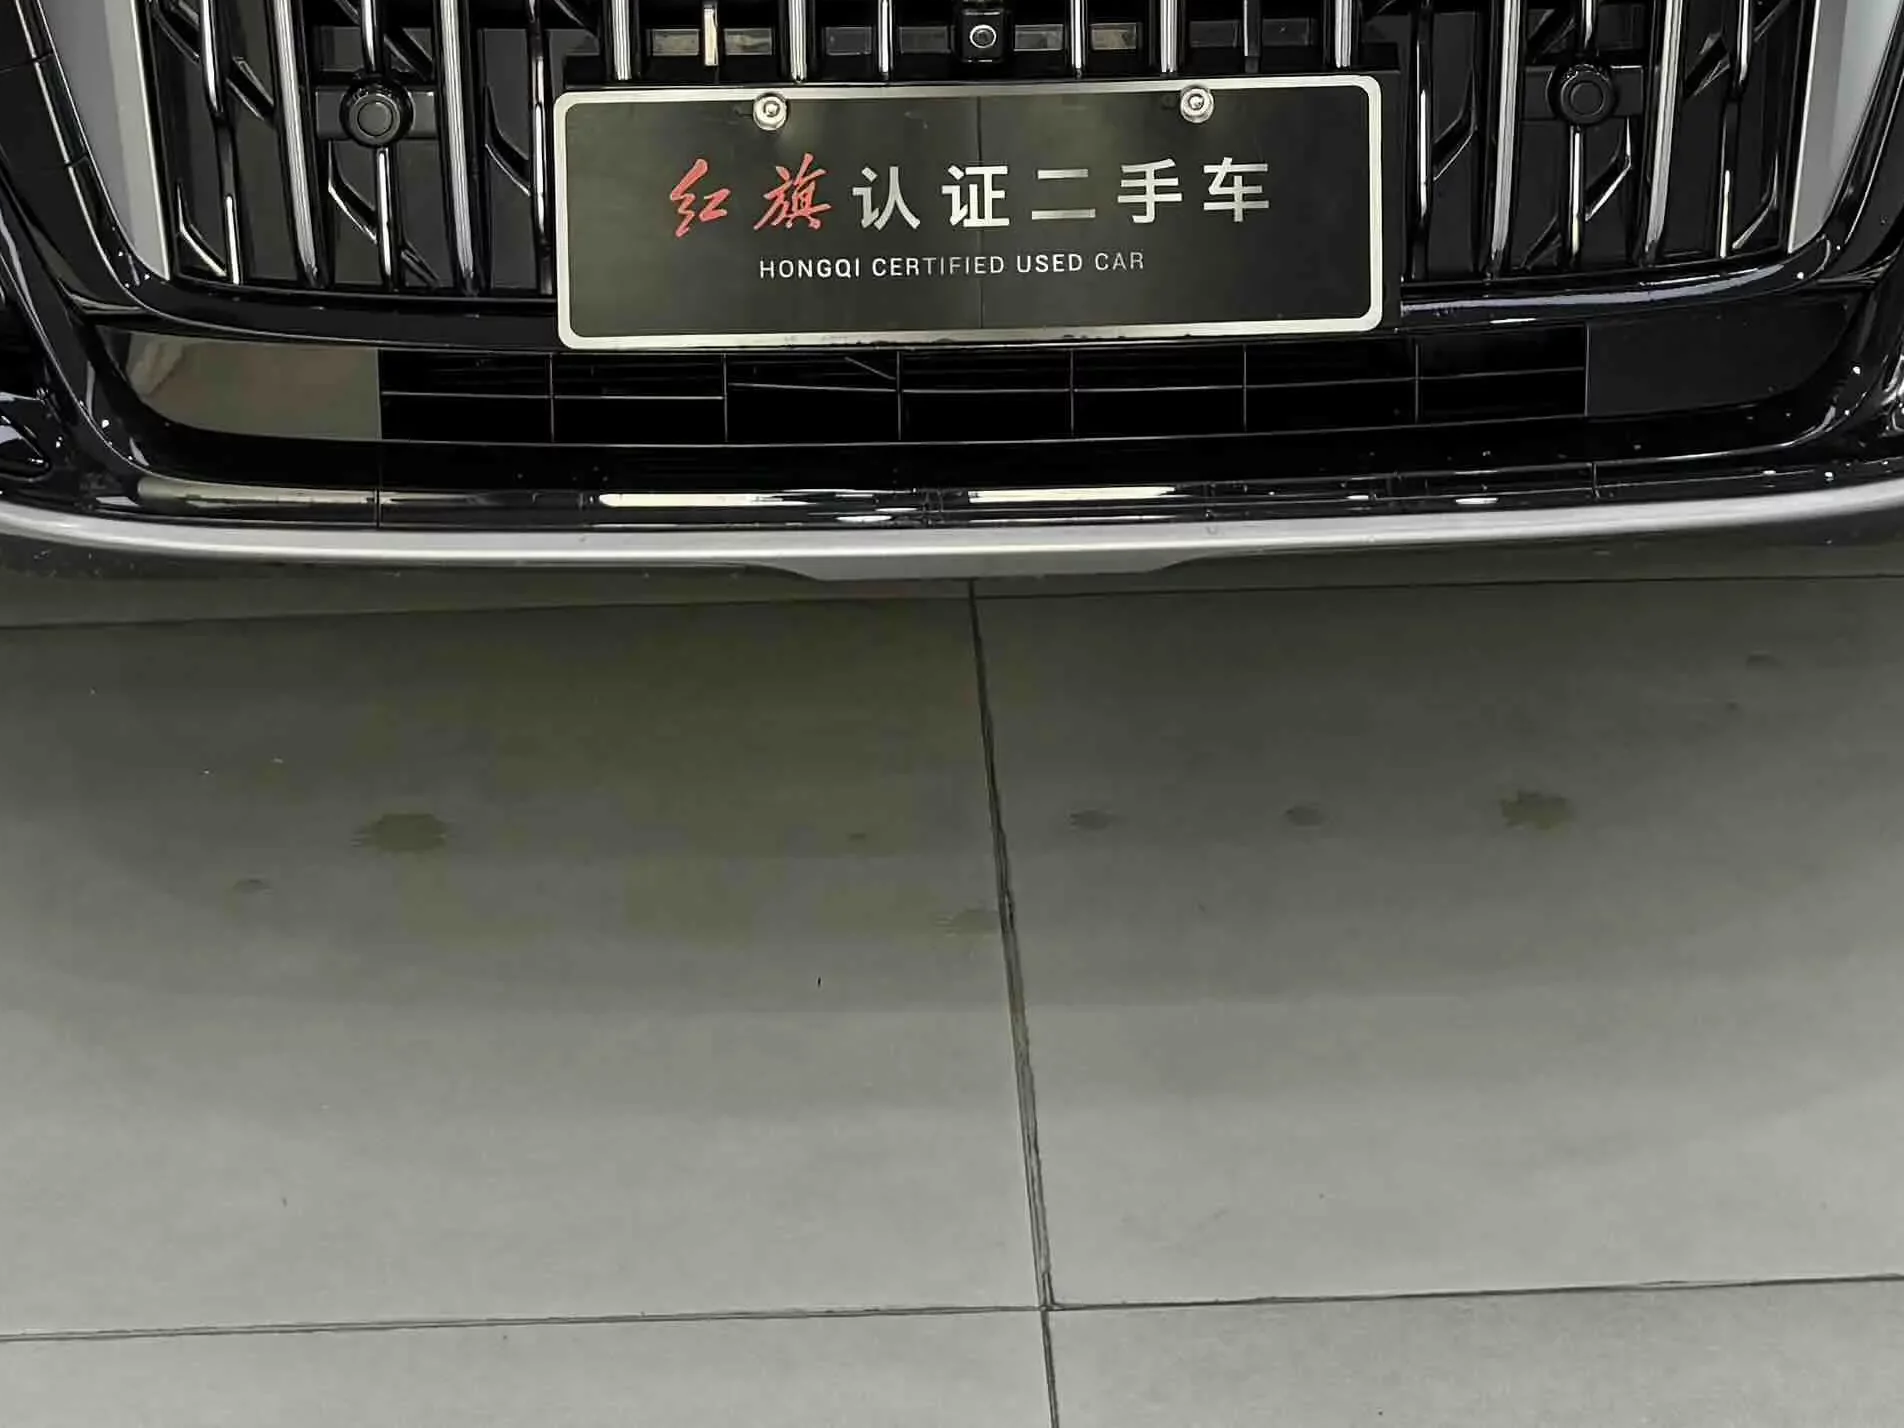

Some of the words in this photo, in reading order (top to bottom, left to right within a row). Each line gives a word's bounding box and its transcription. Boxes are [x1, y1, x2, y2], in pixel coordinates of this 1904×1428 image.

[668, 152, 1271, 239] 红旗认证二手车
[758, 257, 861, 280] HONGQI
[871, 255, 1006, 277] CERTIFIED
[1015, 252, 1084, 275] USED
[1094, 251, 1146, 272] CAR
